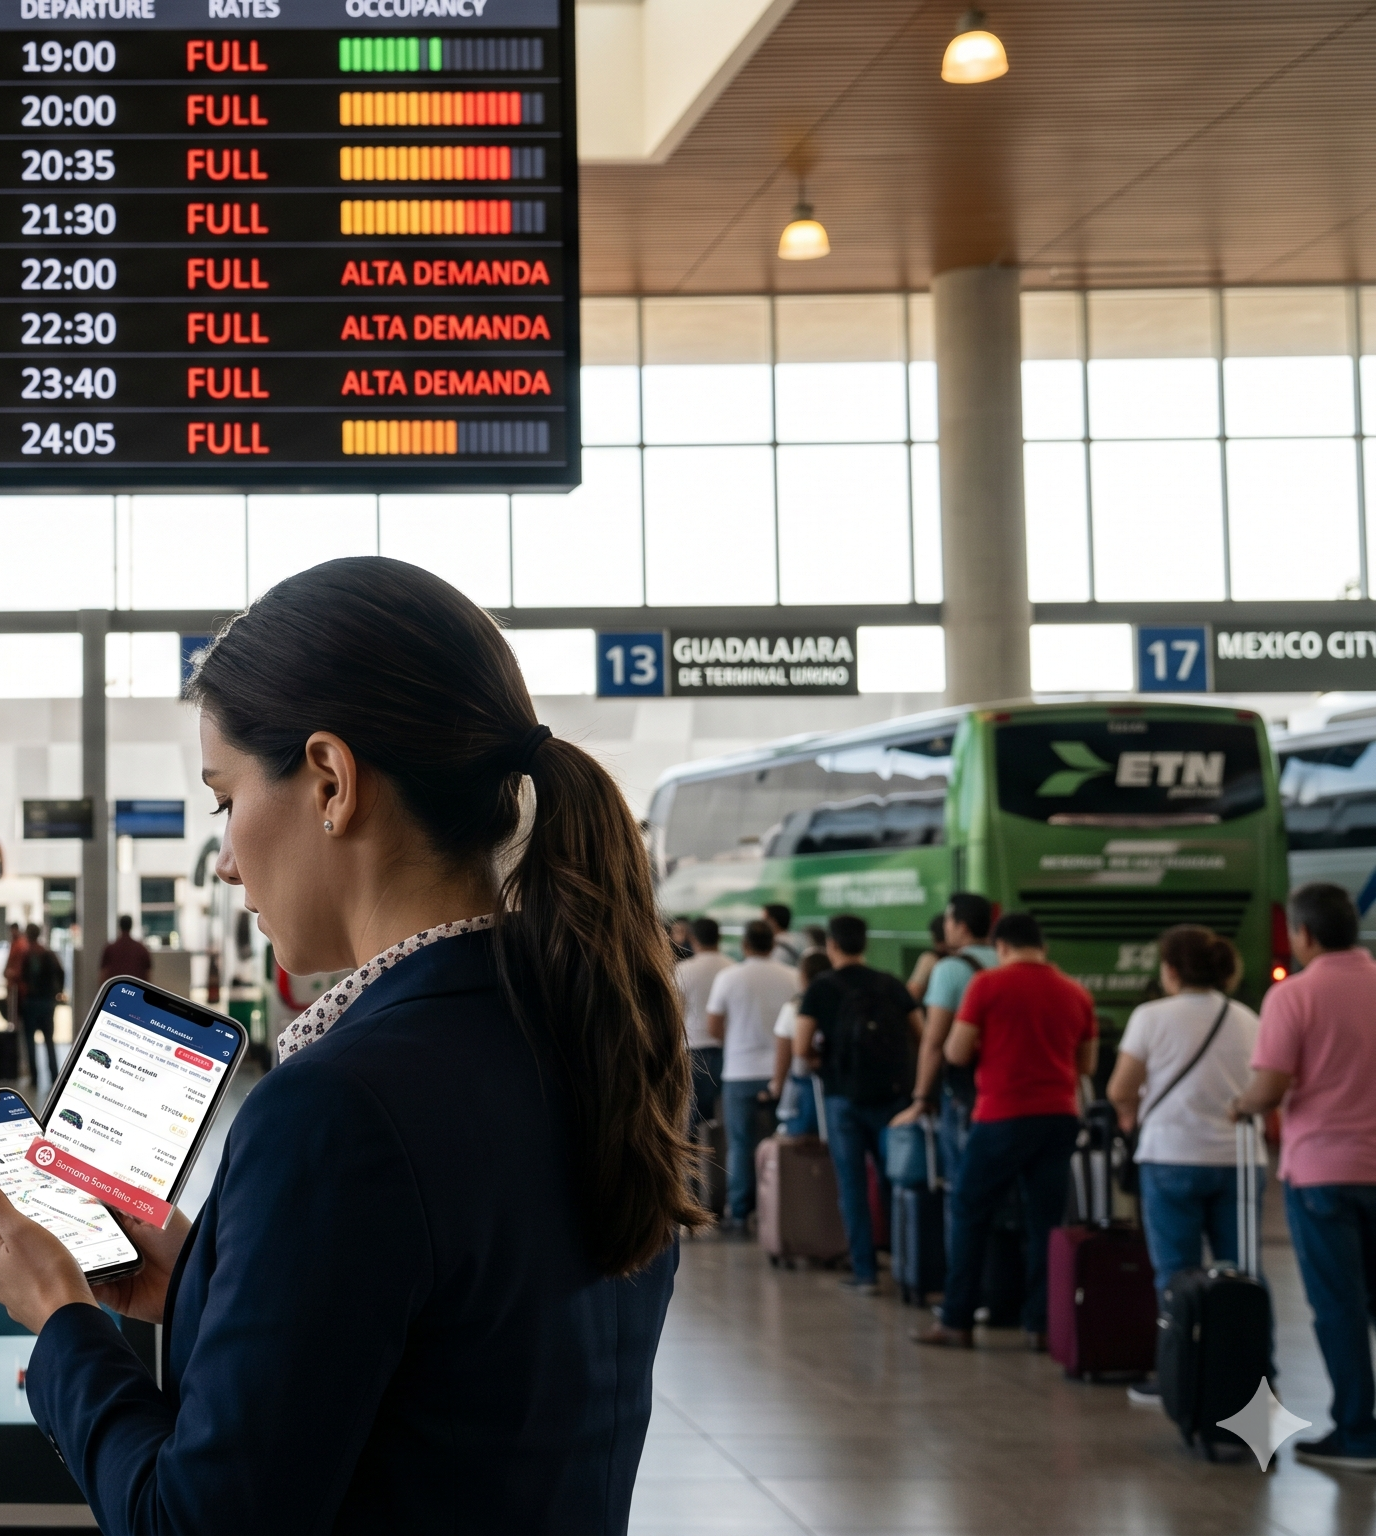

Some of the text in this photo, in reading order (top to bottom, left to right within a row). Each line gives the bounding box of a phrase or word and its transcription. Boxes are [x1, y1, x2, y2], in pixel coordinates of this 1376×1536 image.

[20, 0, 156, 20] DEPARTURE
[208, 0, 282, 19] RATES
[344, 0, 488, 18] OCCUPANCY
[23, 41, 115, 72] 19:00
[187, 40, 268, 72] FULL
[22, 95, 116, 126] 20:00
[187, 95, 268, 126] FULL
[22, 149, 115, 180] 20:35
[187, 149, 268, 180] FULL
[22, 204, 116, 235] 21:30
[188, 203, 268, 234] FULL
[22, 258, 116, 290] 22:00
[188, 258, 269, 290] FULL
[341, 260, 407, 286] ALTA
[414, 260, 550, 286] DEMANDA
[22, 313, 116, 344] 22:30
[188, 313, 269, 344] FULL
[341, 315, 407, 340] ALTA
[414, 315, 550, 340] DEMANDA
[21, 367, 116, 399] 23:40
[188, 367, 269, 399] FULL
[341, 370, 407, 395] ALTA
[414, 370, 551, 395] DEMANDA
[22, 422, 115, 454] 24:05
[188, 423, 270, 454] FULL
[673, 636, 855, 664] GUADALAJARA
[1146, 640, 1201, 682] 17
[1217, 631, 1323, 660] MEXICO
[605, 644, 658, 686] 13
[1115, 751, 1226, 788] ETN
